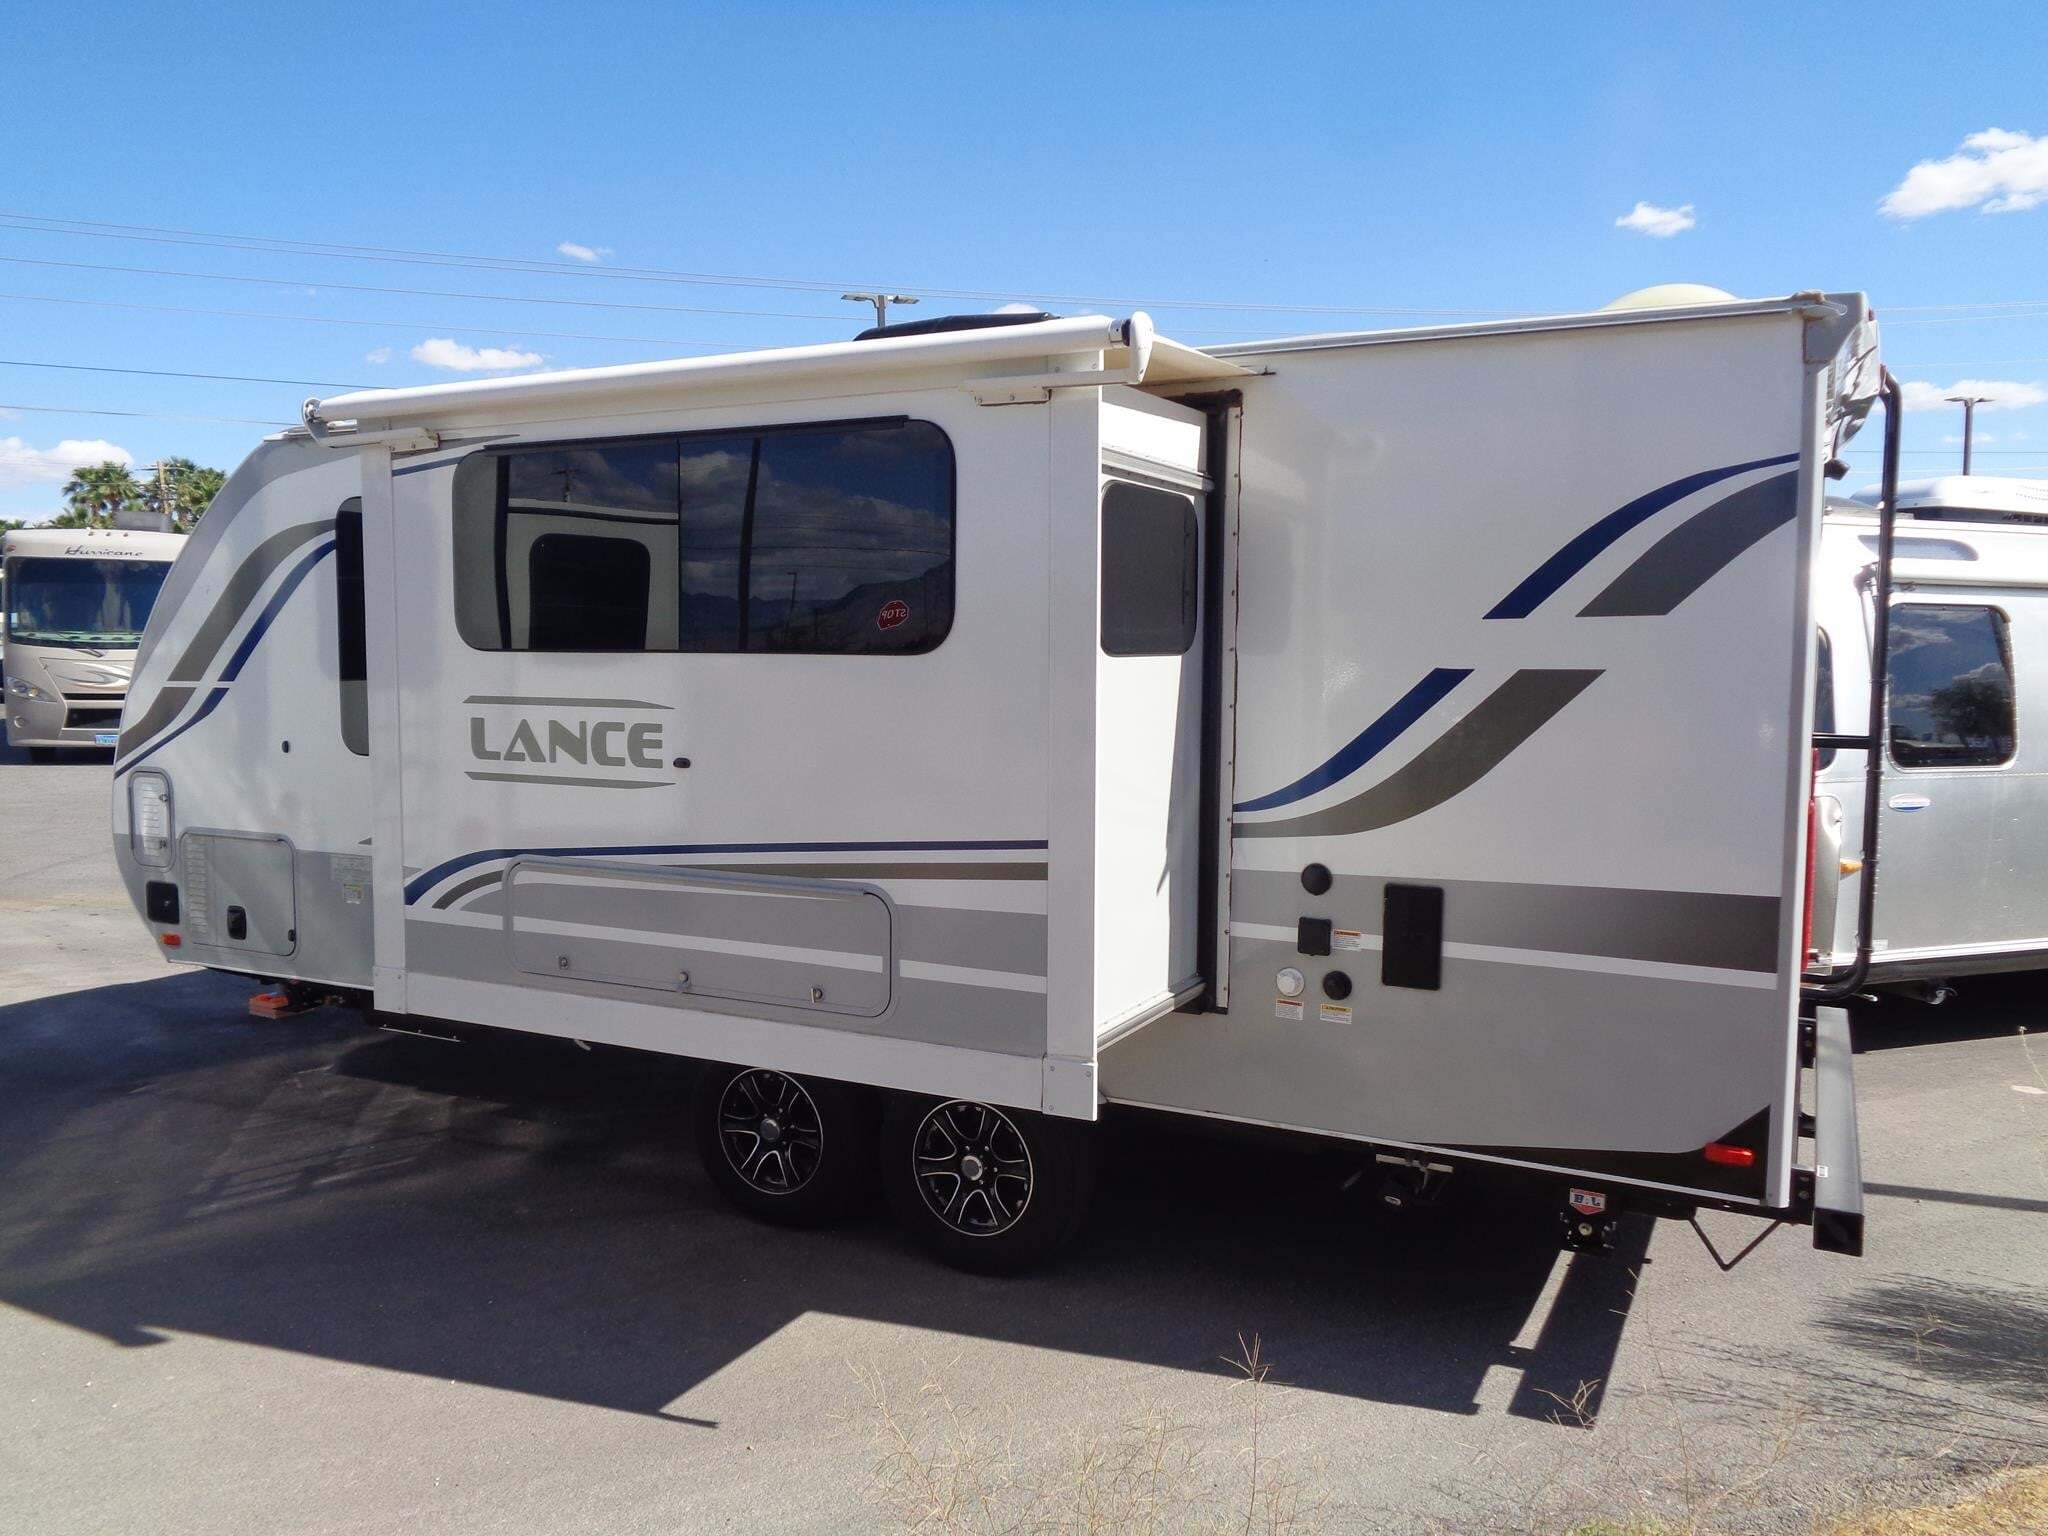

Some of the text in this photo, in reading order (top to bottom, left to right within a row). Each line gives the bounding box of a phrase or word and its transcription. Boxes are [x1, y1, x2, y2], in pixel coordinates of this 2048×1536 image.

[64, 545, 144, 557] Hurricane
[470, 716, 664, 769] LANCE
[1574, 1193, 1601, 1207] BL
